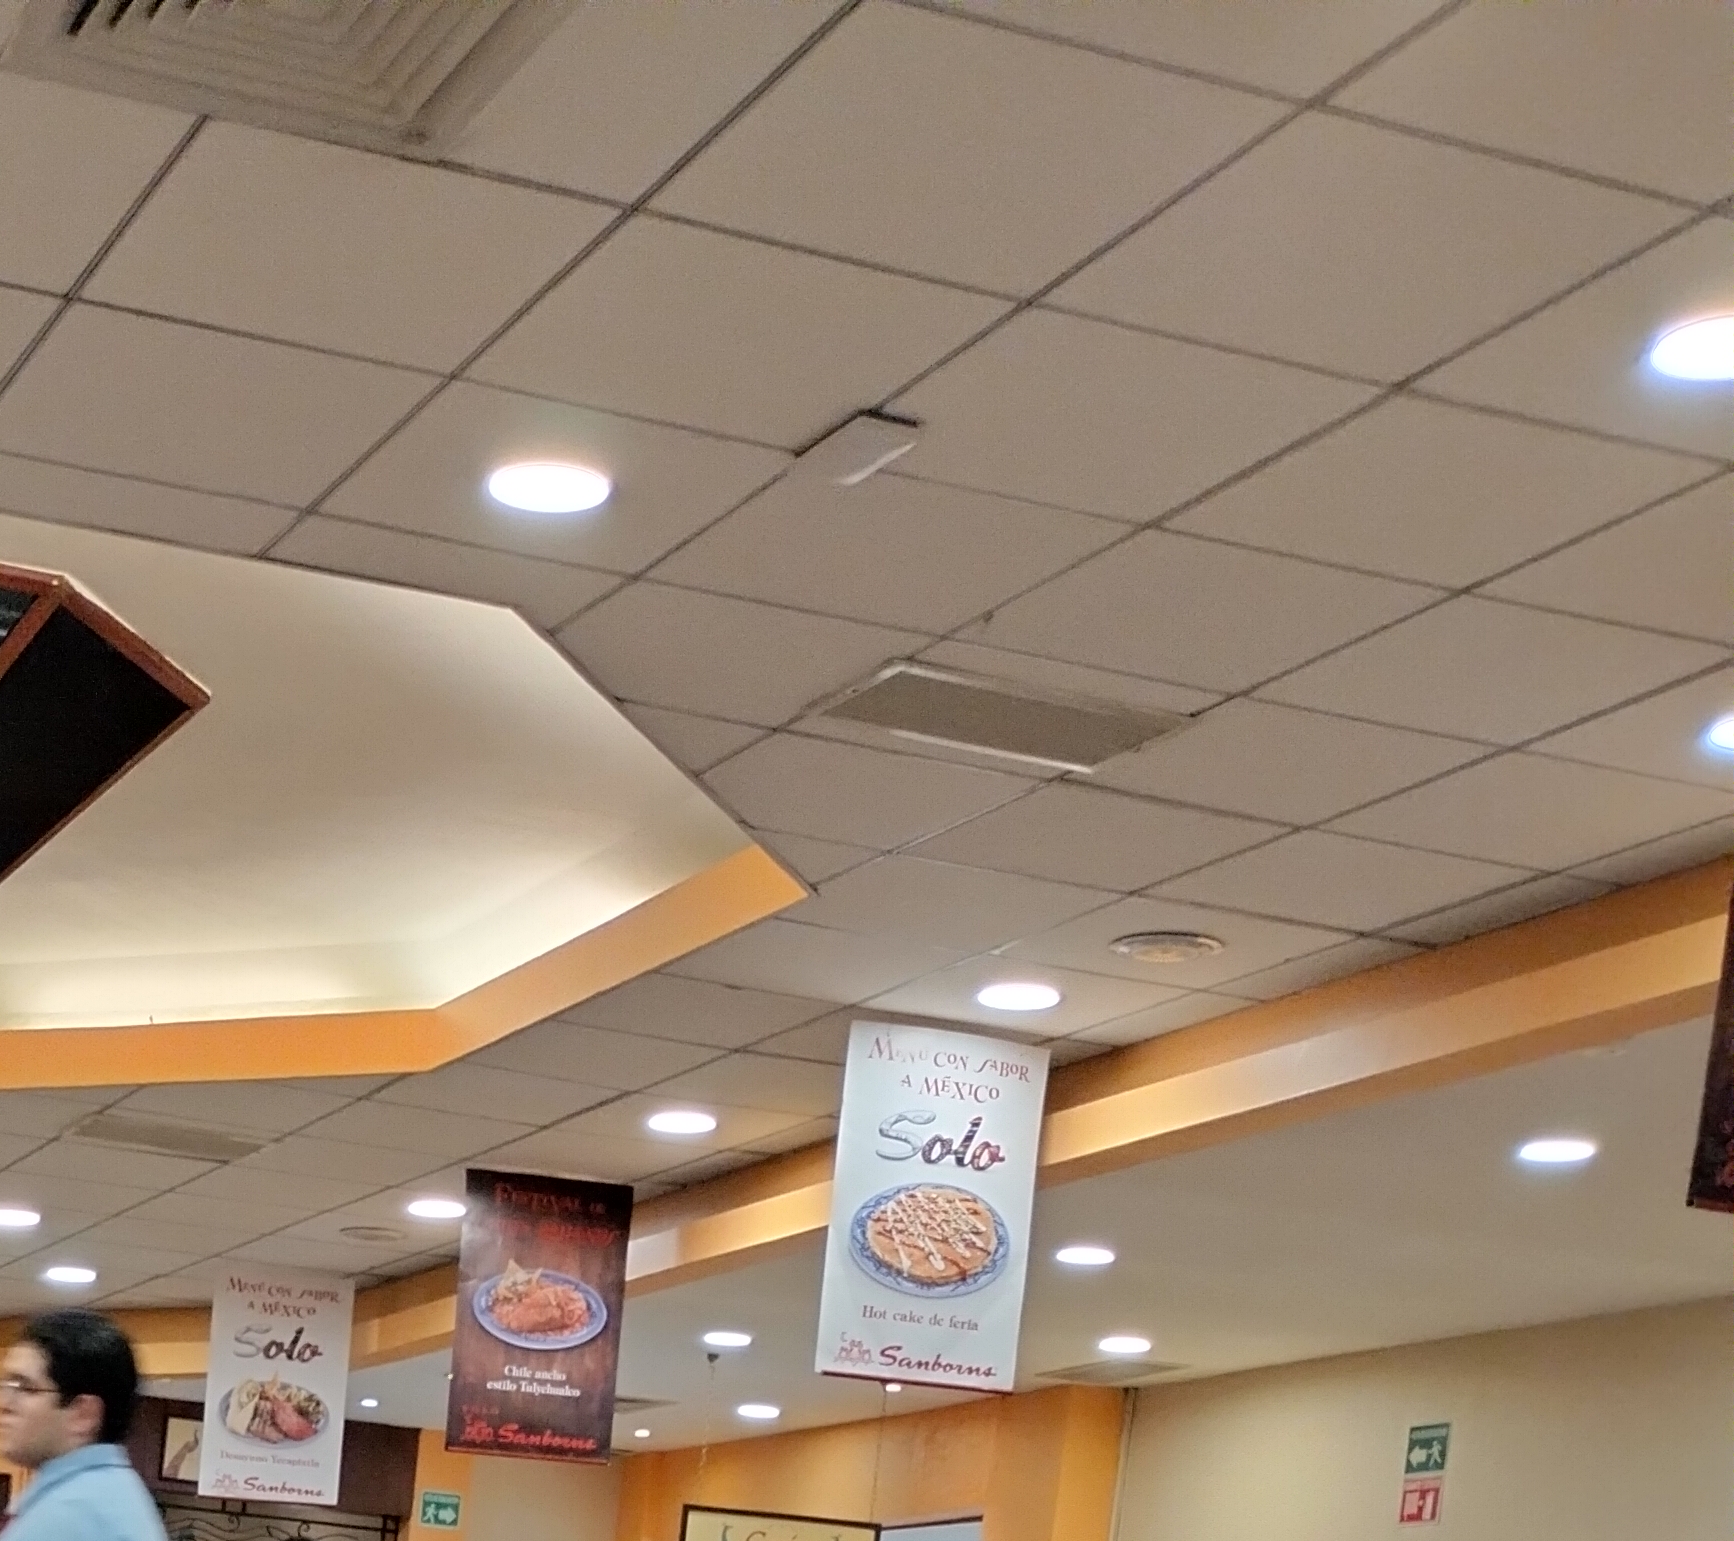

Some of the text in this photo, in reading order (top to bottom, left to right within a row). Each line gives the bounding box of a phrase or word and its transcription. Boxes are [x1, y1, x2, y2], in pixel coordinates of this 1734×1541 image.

[933, 1051, 969, 1072] CON
[974, 1058, 1031, 1083] SABOR
[900, 1074, 1001, 1104] A MÉXICO
[875, 1109, 1006, 1172] Solo
[861, 1304, 979, 1332] Hot cake de feria
[232, 1322, 324, 1364] Solo
[504, 1364, 567, 1381] Chile ancho
[878, 1345, 997, 1379] Sanborns
[486, 1379, 517, 1392] estilo
[498, 1422, 598, 1450] Sanborns
[243, 1476, 325, 1498] Sanborns
